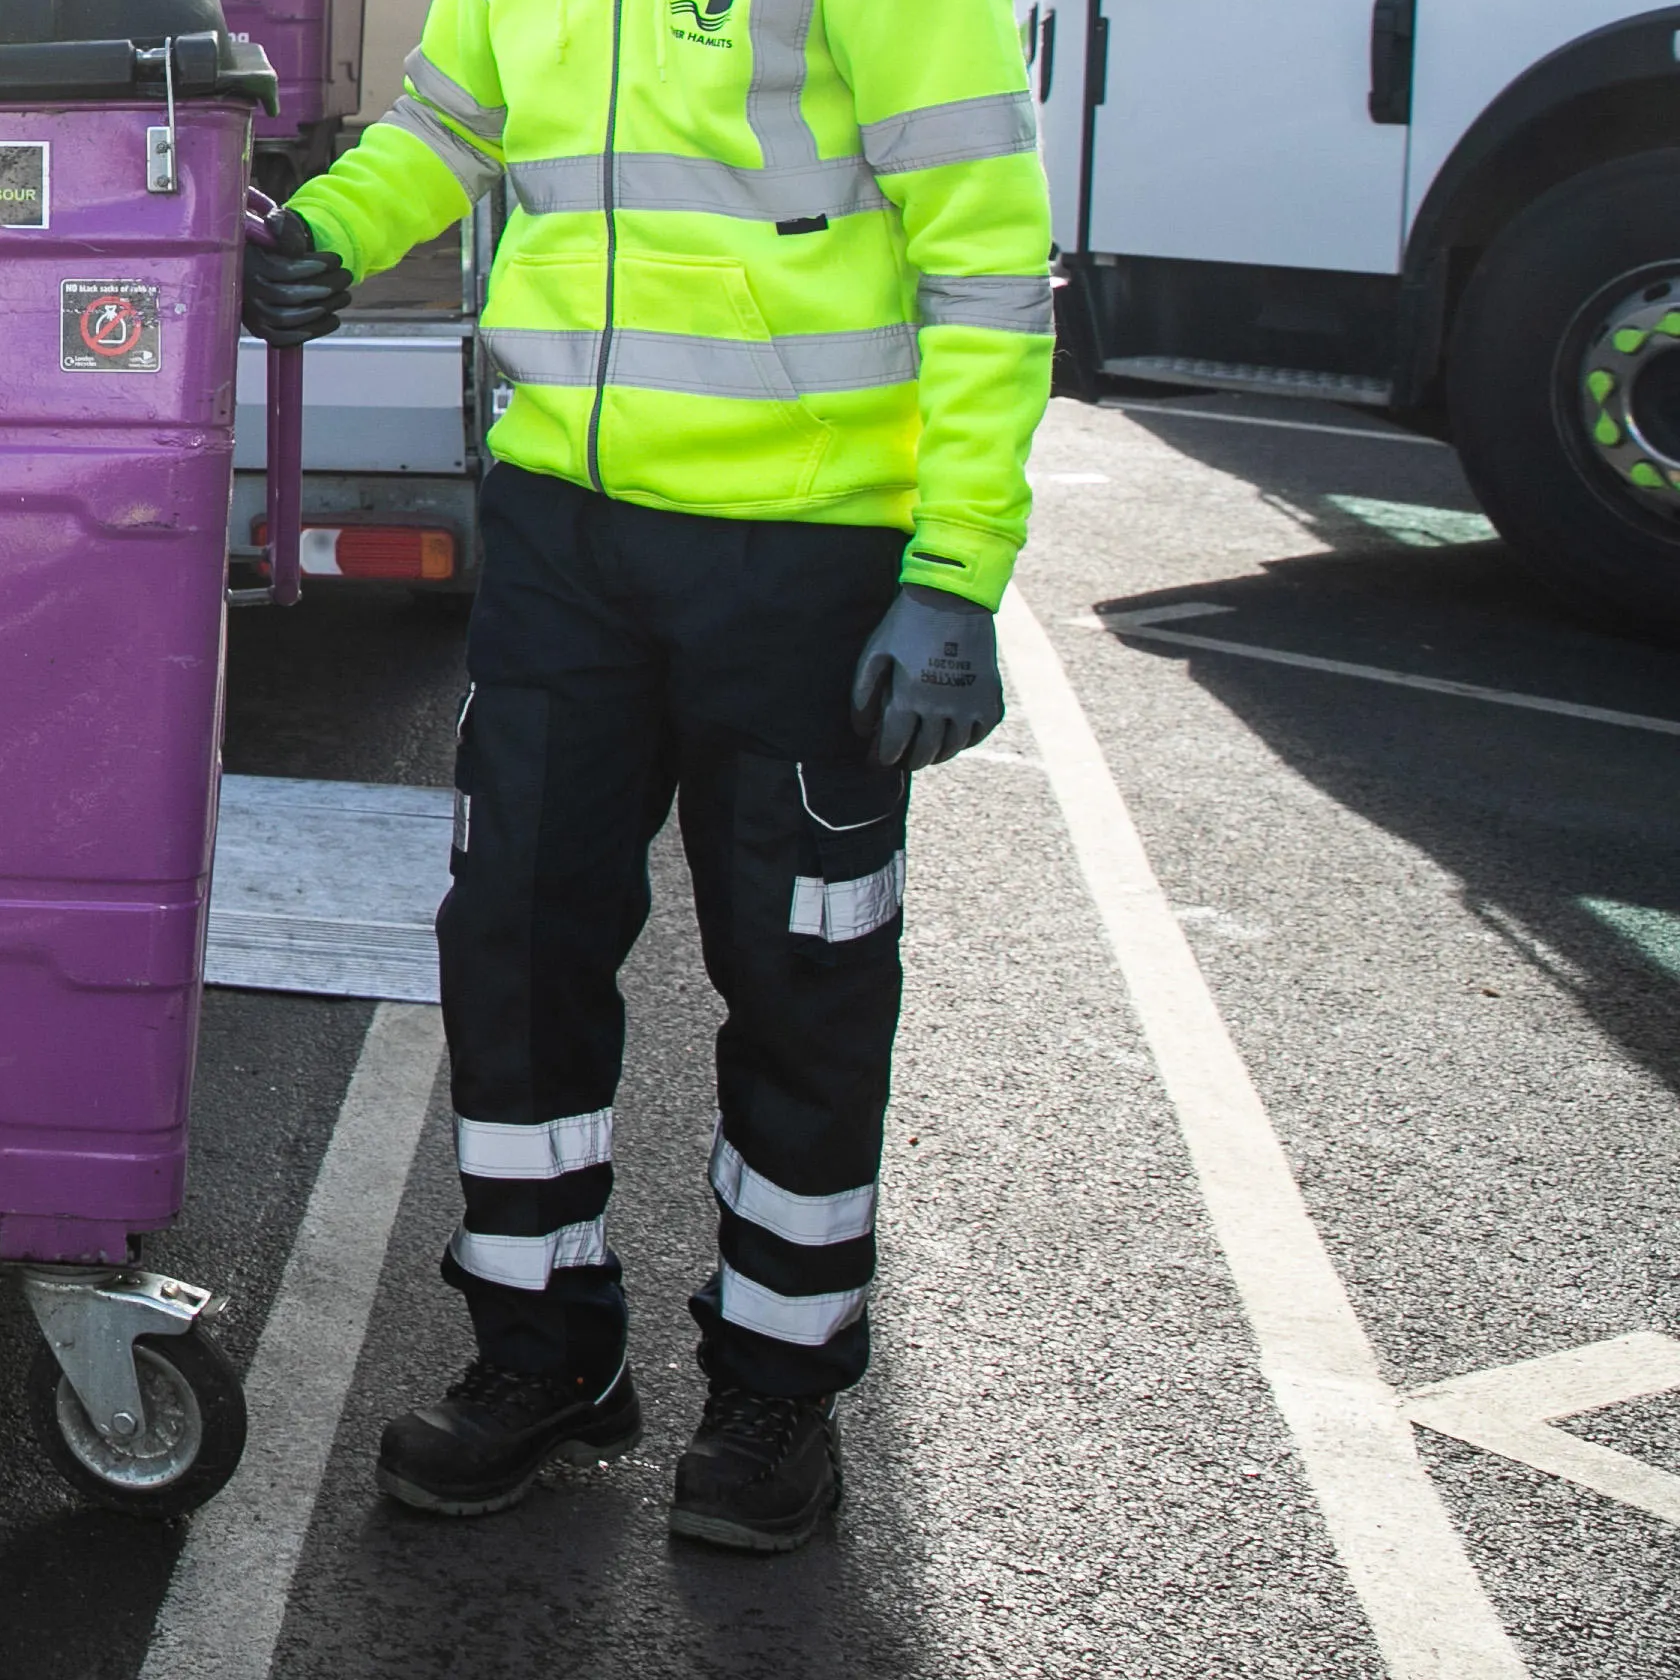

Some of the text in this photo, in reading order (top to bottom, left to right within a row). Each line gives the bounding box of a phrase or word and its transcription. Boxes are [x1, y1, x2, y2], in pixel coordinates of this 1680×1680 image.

[687, 31, 733, 49] HAMLETS
[65, 284, 77, 292] NO
[79, 284, 98, 292] black
